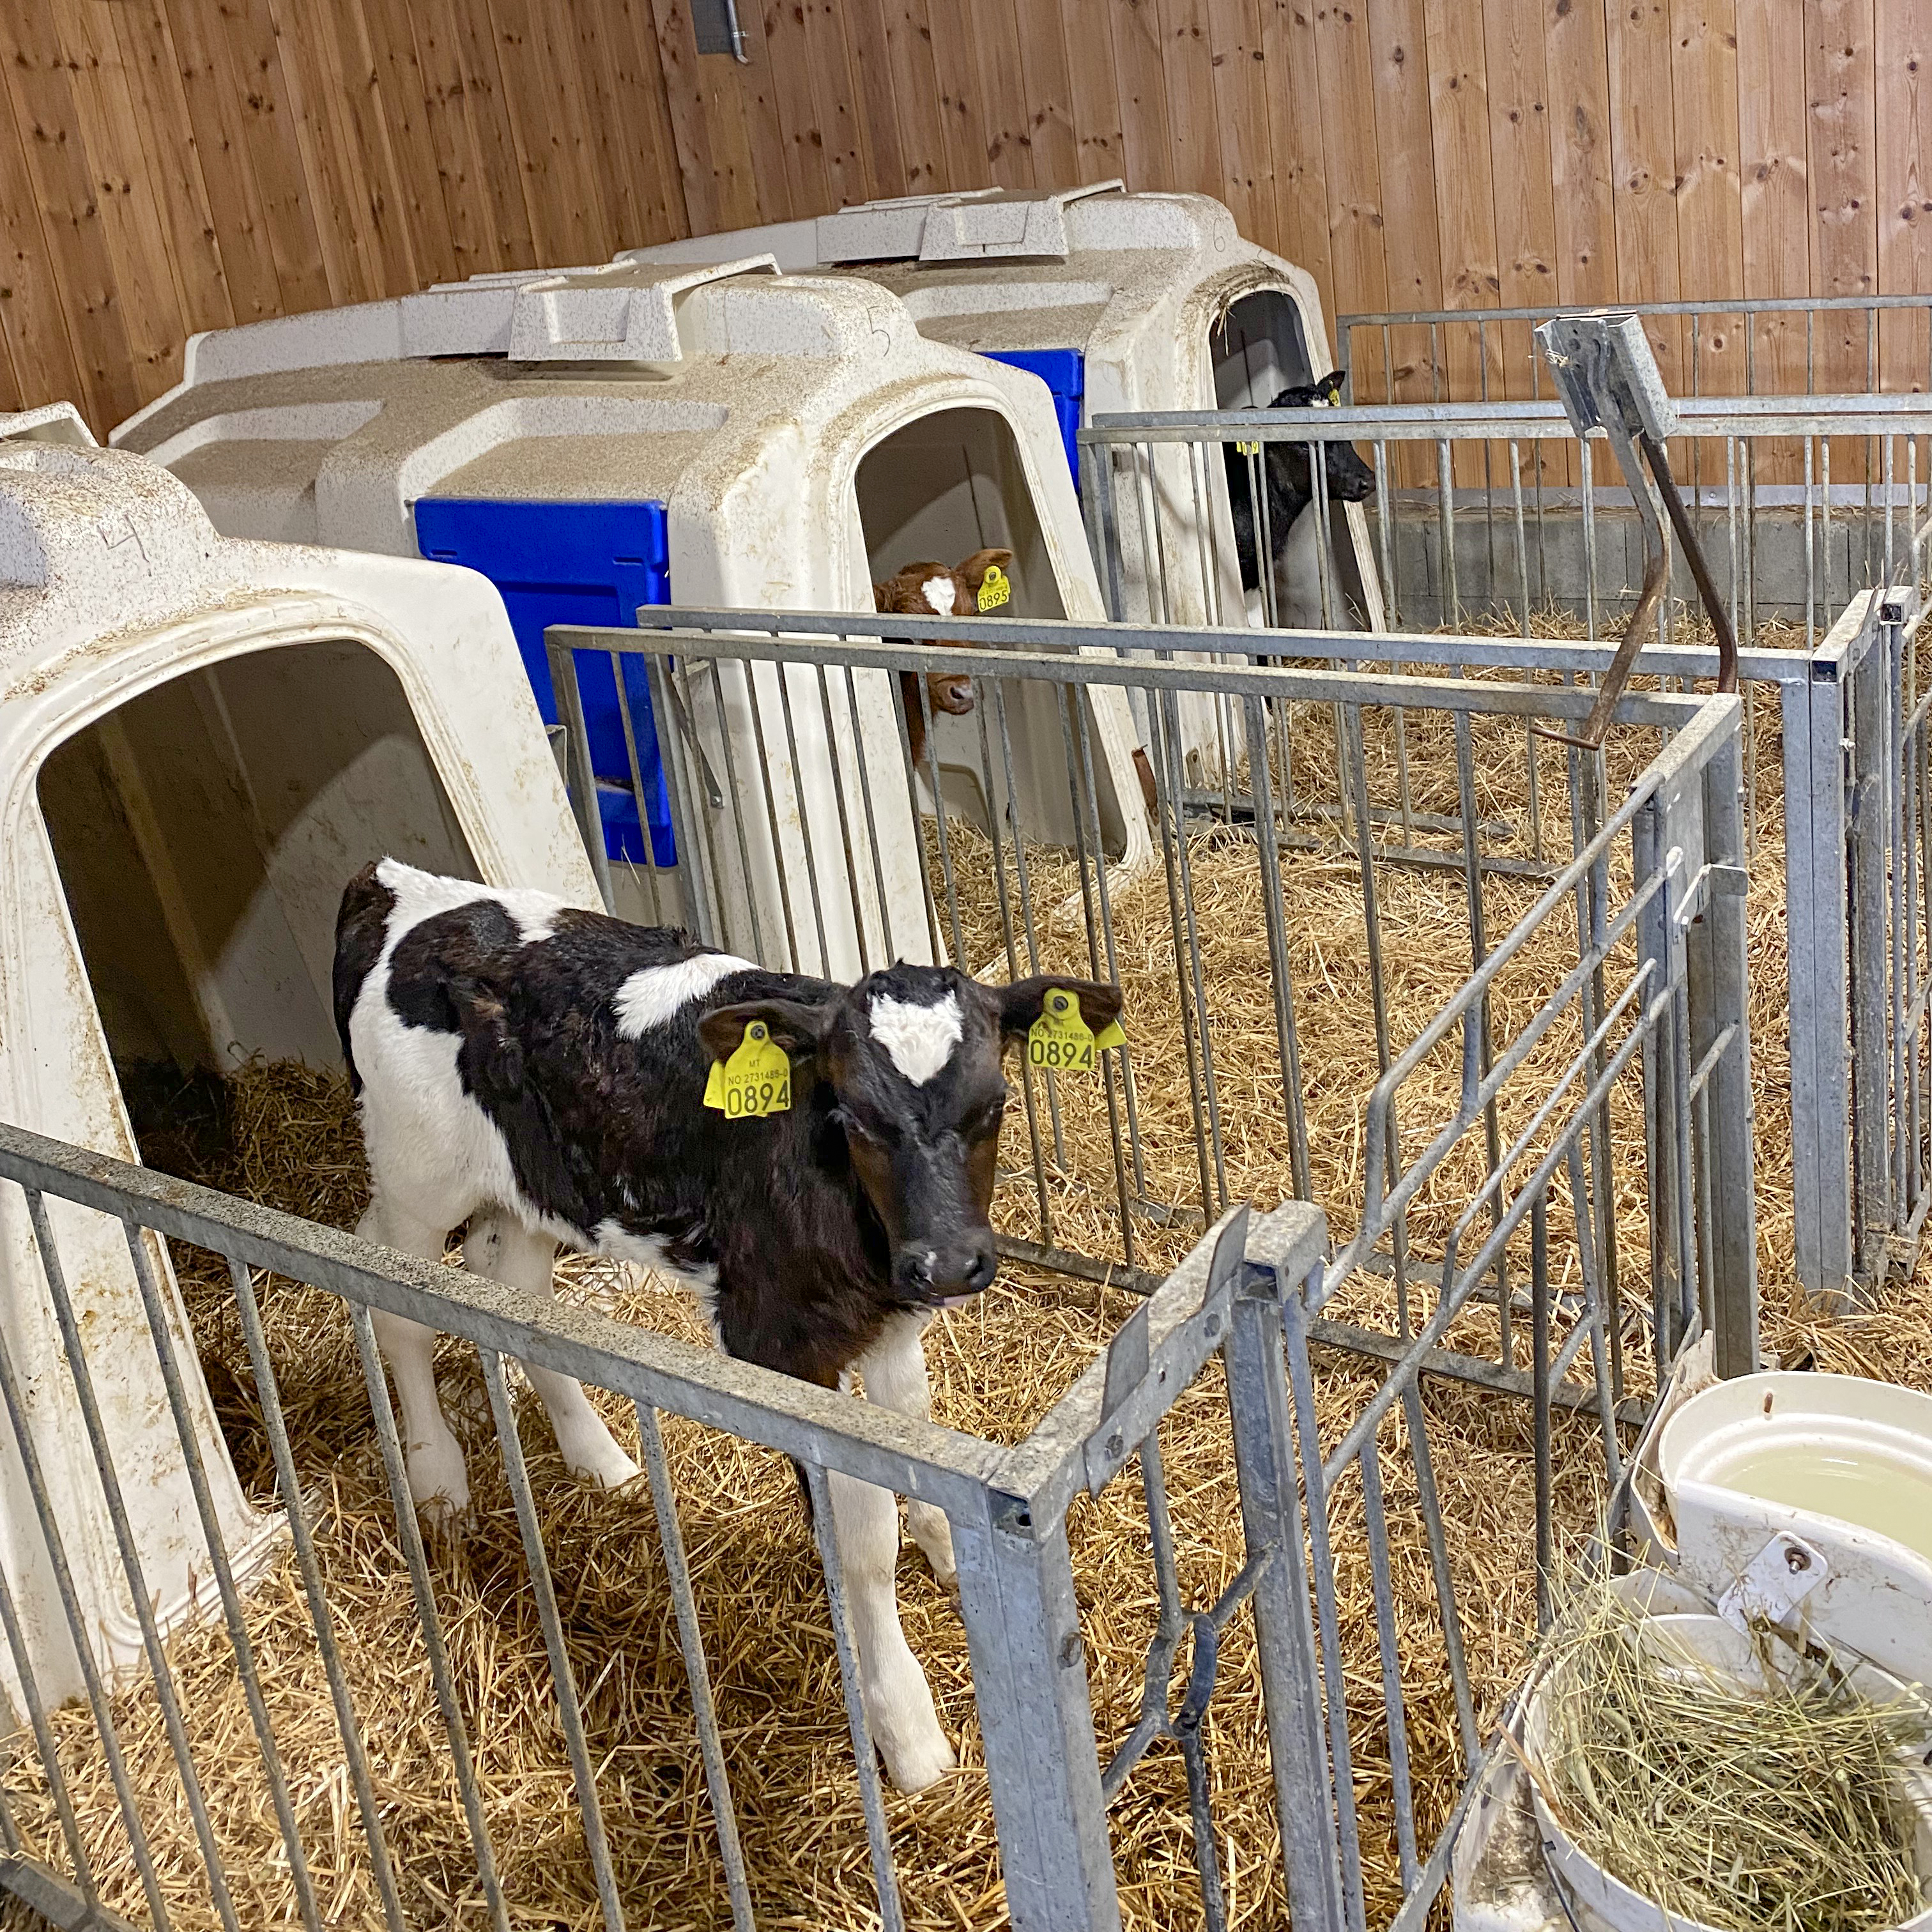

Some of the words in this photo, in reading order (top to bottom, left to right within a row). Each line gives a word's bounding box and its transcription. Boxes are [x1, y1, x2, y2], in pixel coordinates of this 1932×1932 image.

[866, 305, 890, 357] 5
[979, 590, 1008, 610] 0895
[1031, 1028, 1044, 1037] NO
[749, 1059, 760, 1068] MT
[1030, 1039, 1093, 1069] 0894
[728, 1075, 741, 1085] NO
[727, 1080, 789, 1116] 0894
